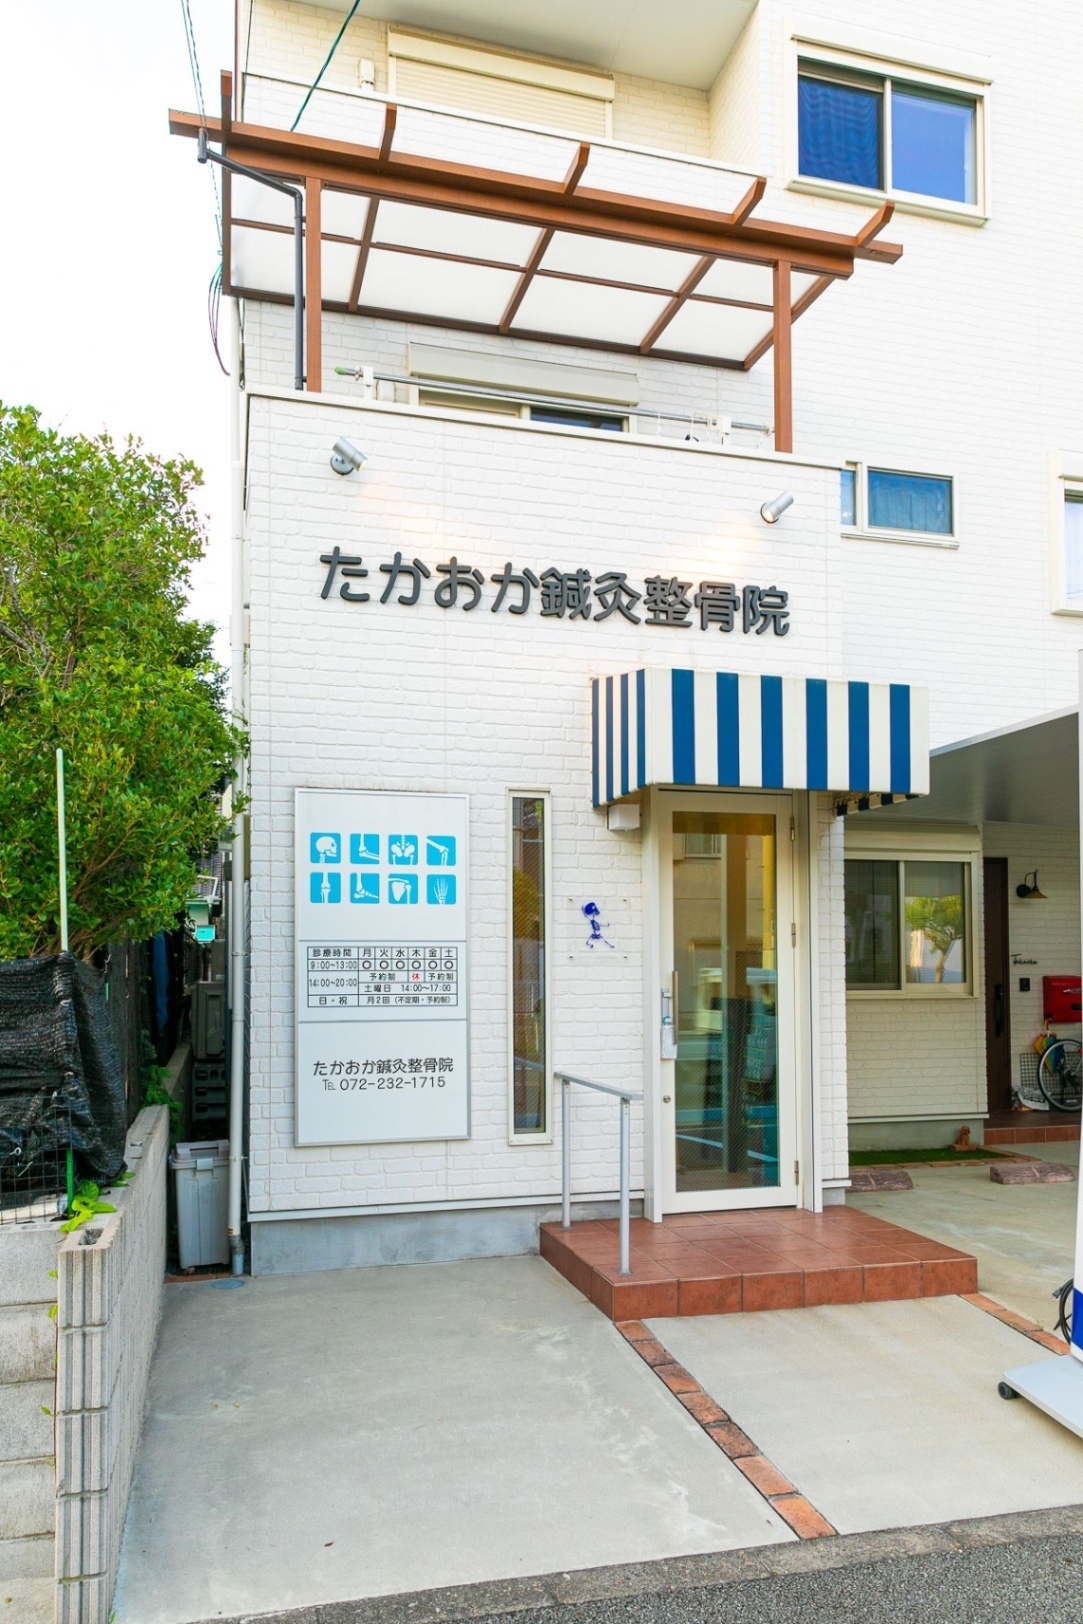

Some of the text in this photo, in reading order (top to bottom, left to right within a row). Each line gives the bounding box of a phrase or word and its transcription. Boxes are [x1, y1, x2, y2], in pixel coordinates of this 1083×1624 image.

[319, 546, 790, 636] たかおか鍼灸整骨院
[312, 948, 352, 958] 診療時間
[362, 948, 454, 958] 月 火 水 木 金 土
[369, 972, 454, 981] 予約制 休 予約制
[364, 984, 392, 993] 土曜日
[313, 1057, 454, 1077] たかおか鍼灸整骨院
[339, 1076, 446, 1091] 072-232-1715
